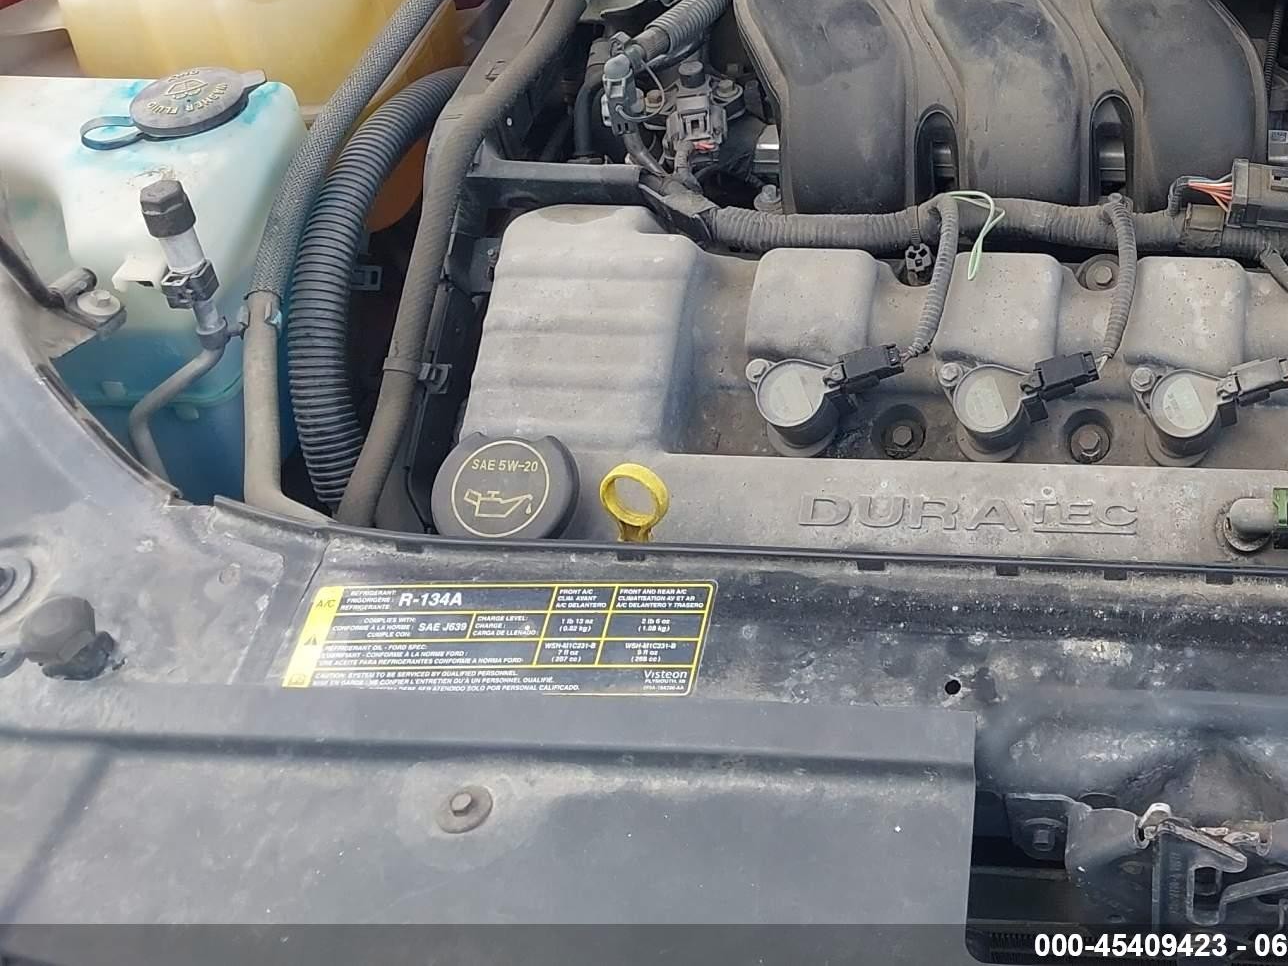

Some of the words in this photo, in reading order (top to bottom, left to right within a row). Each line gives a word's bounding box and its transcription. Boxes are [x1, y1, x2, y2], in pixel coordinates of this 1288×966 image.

[472, 459, 495, 471] SAE
[498, 460, 539, 472] 5W-20
[797, 493, 1138, 533] DURATEC
[316, 599, 336, 608] A/C
[399, 592, 462, 606] R-134A
[418, 622, 440, 632] SAE
[442, 622, 468, 632] J639
[644, 670, 688, 678] Visteon
